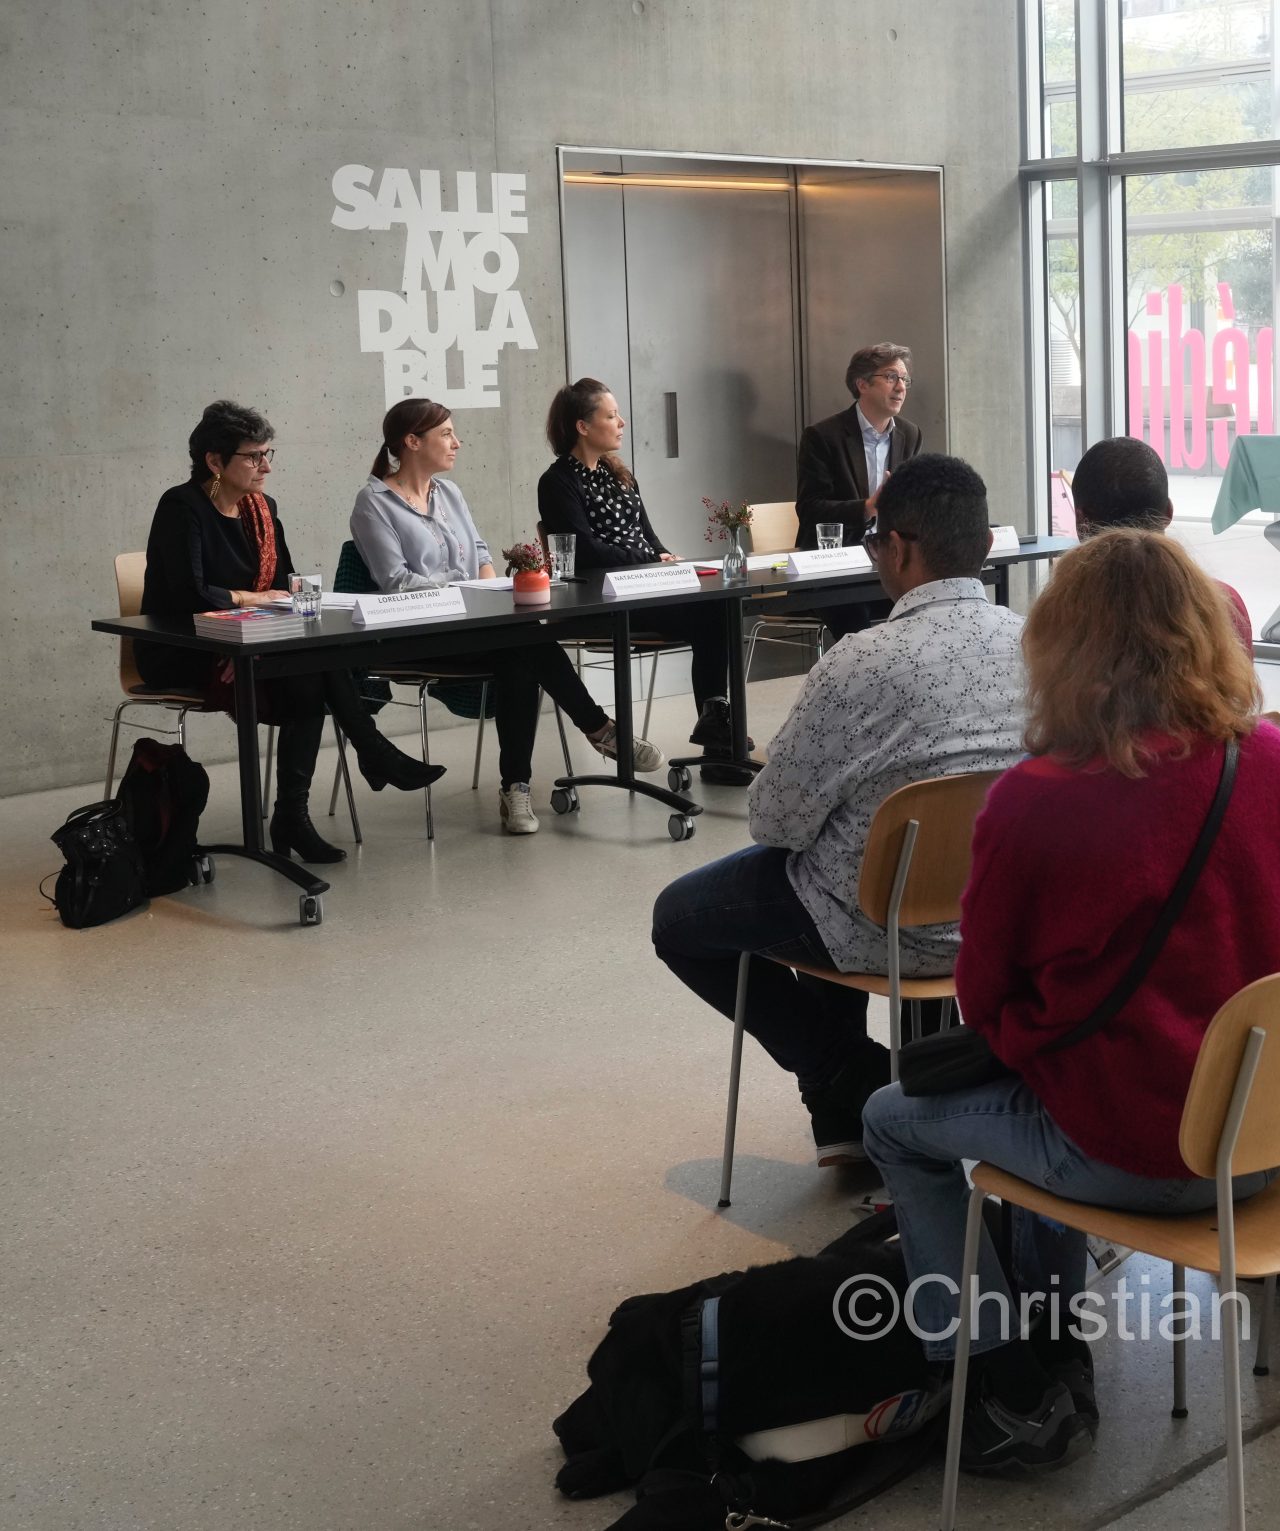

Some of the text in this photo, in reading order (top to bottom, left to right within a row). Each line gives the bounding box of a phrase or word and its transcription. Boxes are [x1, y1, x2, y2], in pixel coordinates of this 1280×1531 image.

[331, 164, 528, 233] SALLE
[401, 230, 519, 294] MO
[358, 289, 539, 353] DULA
[383, 349, 501, 412] BLE
[377, 591, 441, 604] LORELLA BERTANI
